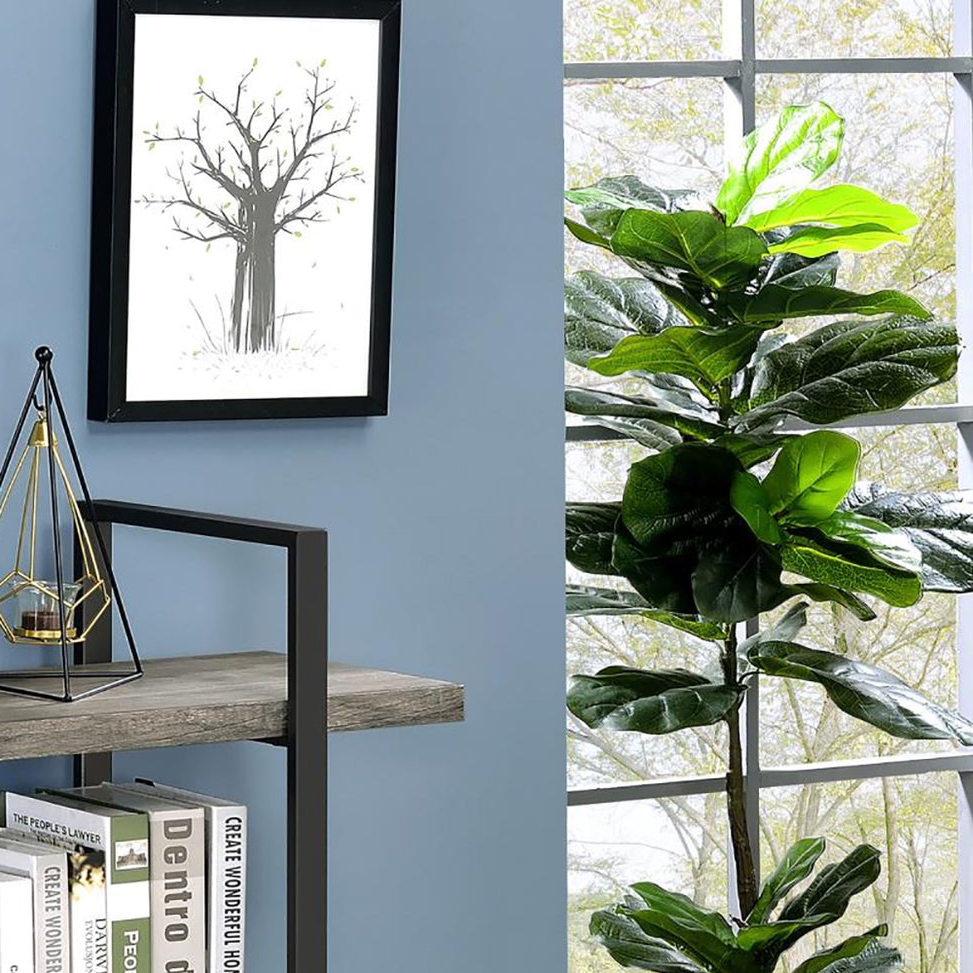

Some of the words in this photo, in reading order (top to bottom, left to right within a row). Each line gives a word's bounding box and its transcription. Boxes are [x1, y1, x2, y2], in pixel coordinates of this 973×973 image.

[13, 813, 28, 826] THE
[30, 817, 67, 835] PEOPLE'S
[68, 828, 101, 844] LAWYER
[224, 816, 242, 863] CREATE
[44, 866, 61, 912] CREATE
[163, 818, 193, 942] Dentro
[224, 866, 241, 946] WONDERFUL
